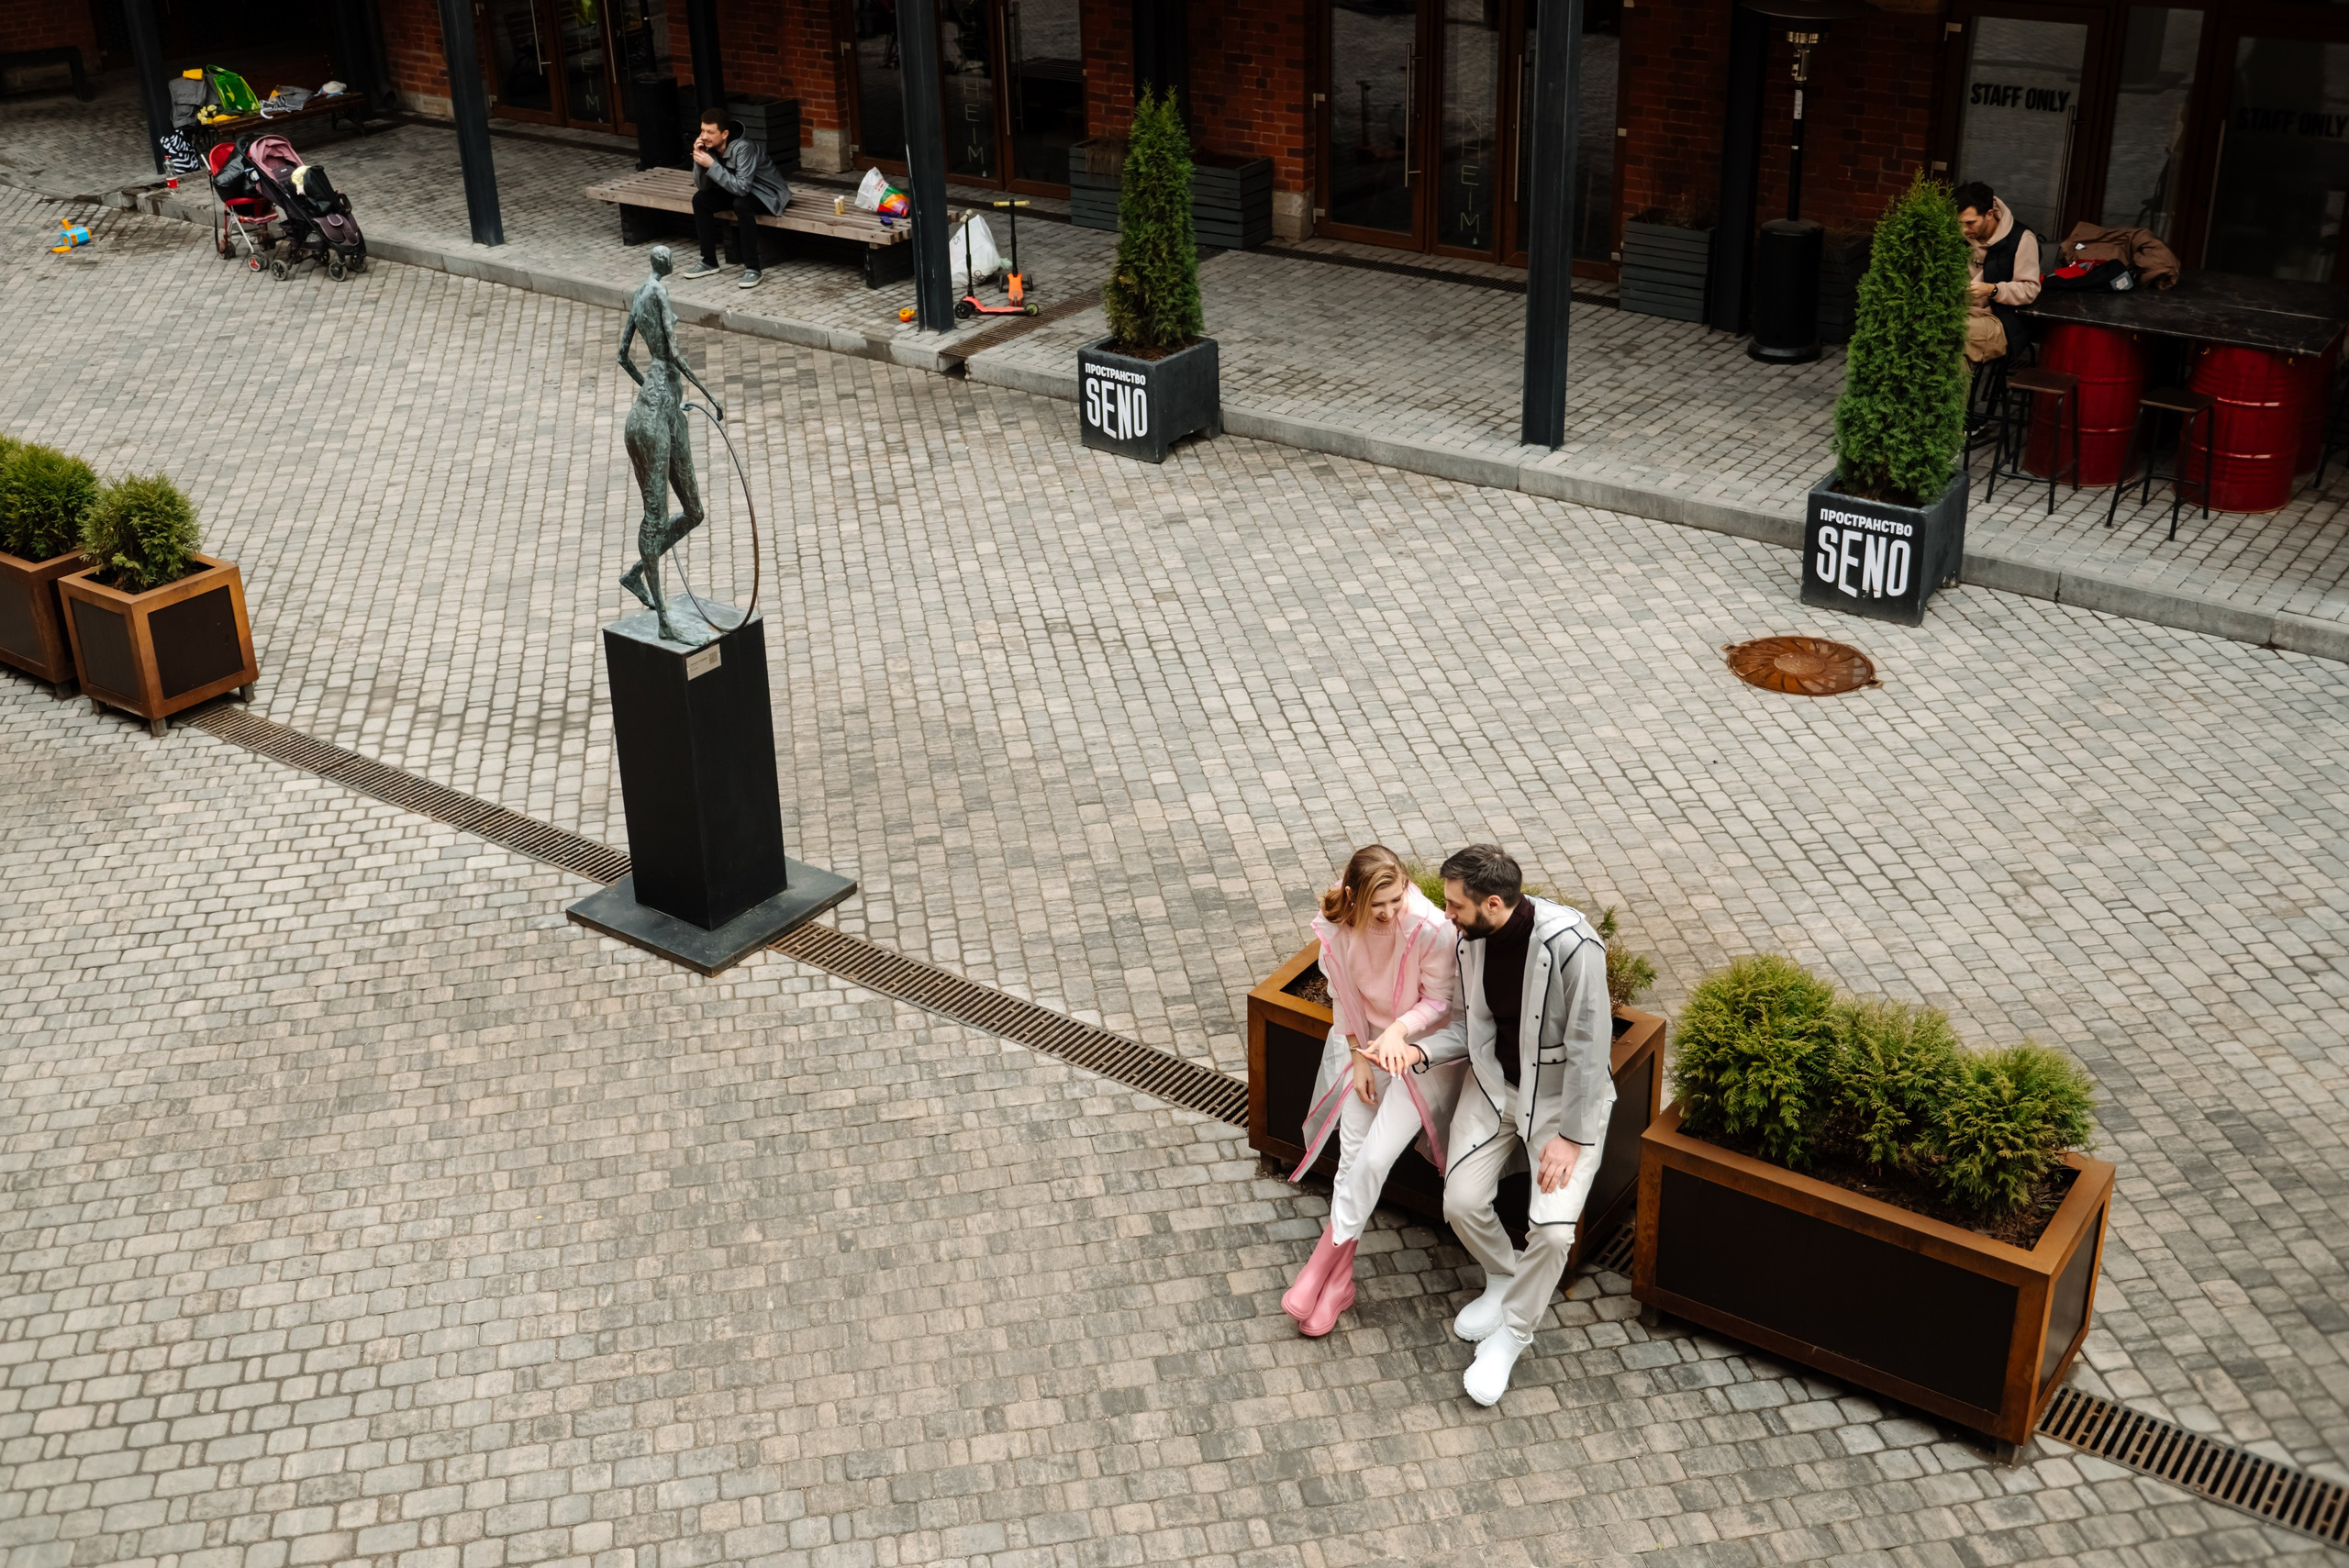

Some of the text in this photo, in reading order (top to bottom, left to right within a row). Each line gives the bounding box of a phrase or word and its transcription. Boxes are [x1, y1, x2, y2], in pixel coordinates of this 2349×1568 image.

[1970, 83, 2071, 114] STAFF ONLY
[2237, 107, 2349, 139] STAFF ONLY
[1085, 362, 1146, 386] ПРОСТРАНСТВО
[1085, 377, 1148, 440] SENO
[1820, 507, 1913, 538] ПРОСТРАНСТВО
[1816, 525, 1911, 599] SENO
